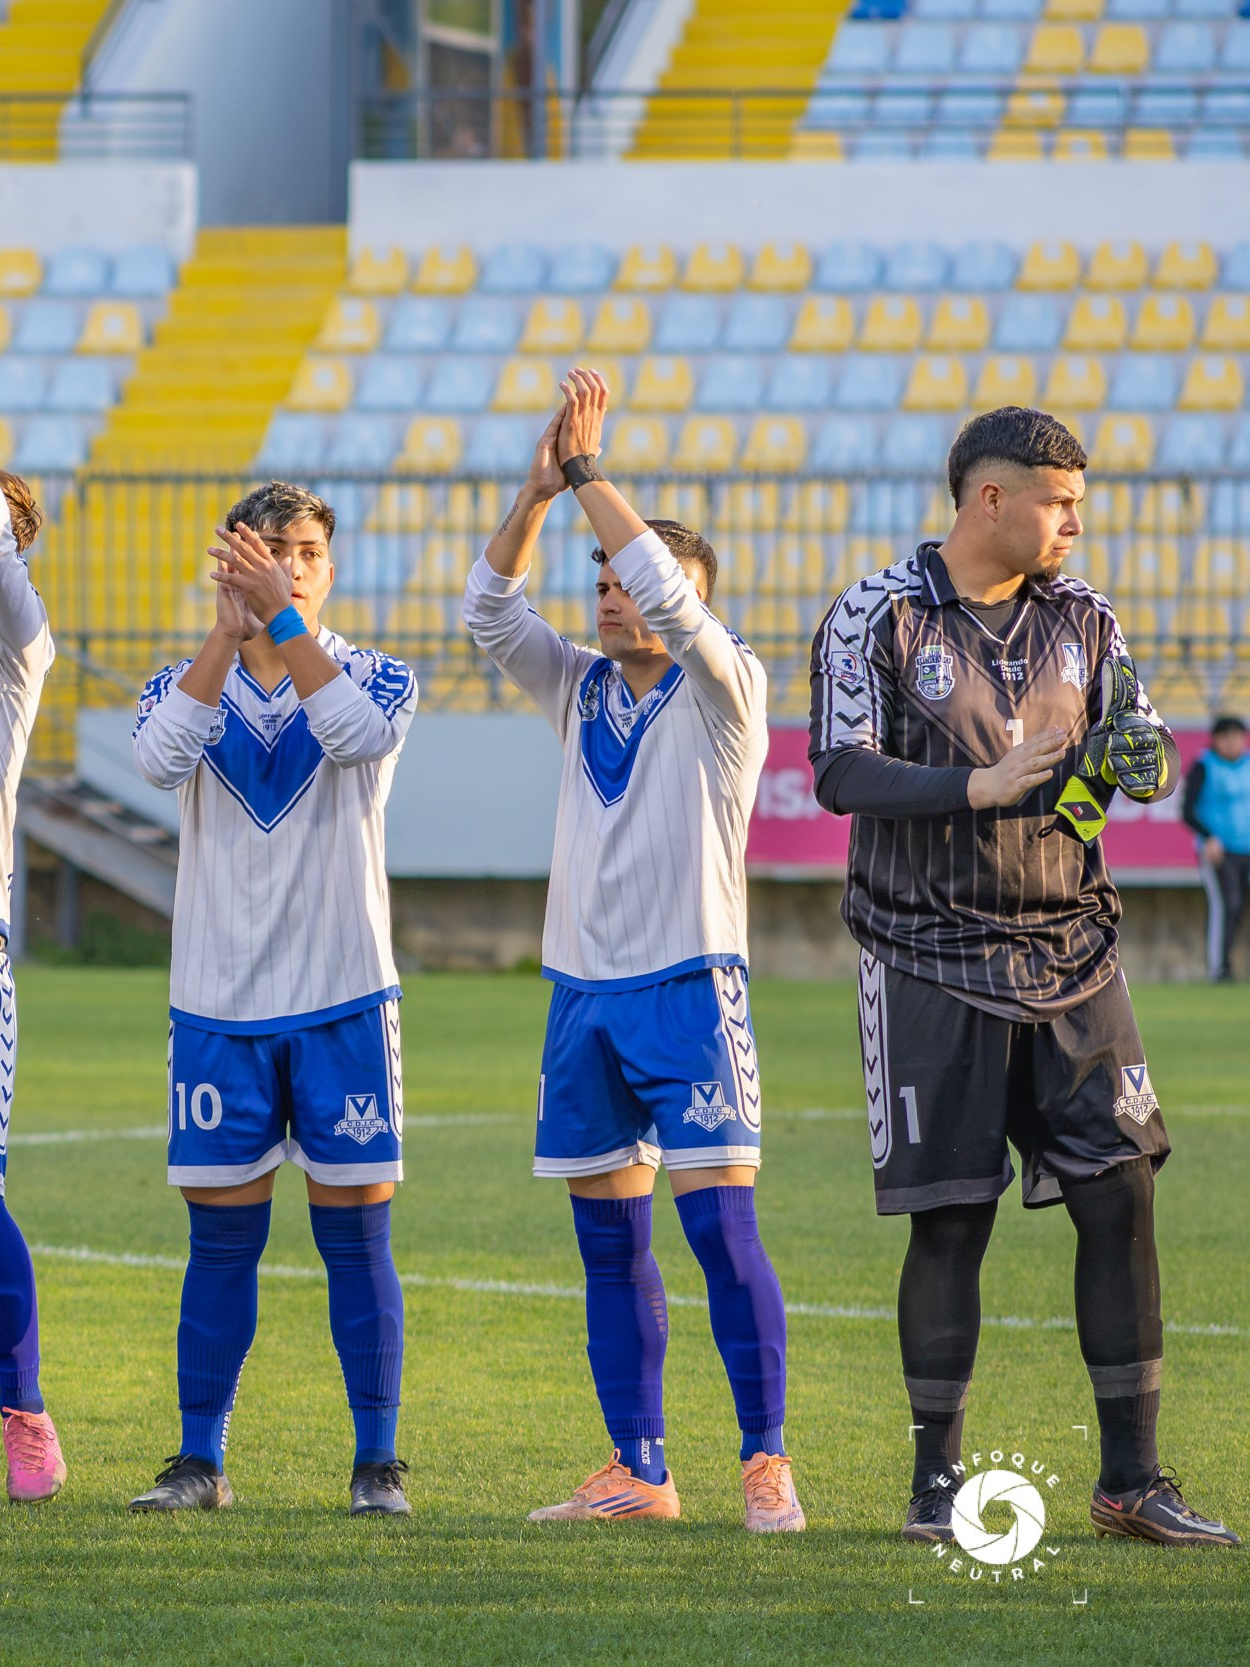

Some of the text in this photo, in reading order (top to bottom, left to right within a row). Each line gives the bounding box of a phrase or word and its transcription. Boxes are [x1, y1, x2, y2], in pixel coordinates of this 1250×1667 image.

[1001, 671, 1024, 681] 1912
[1006, 718, 1024, 747] 1
[176, 1082, 223, 1131] 10
[1131, 1104, 1149, 1118] 1912
[699, 1115, 719, 1126] 1912
[899, 1086, 921, 1144] 1
[353, 1127, 372, 1139] 1912
